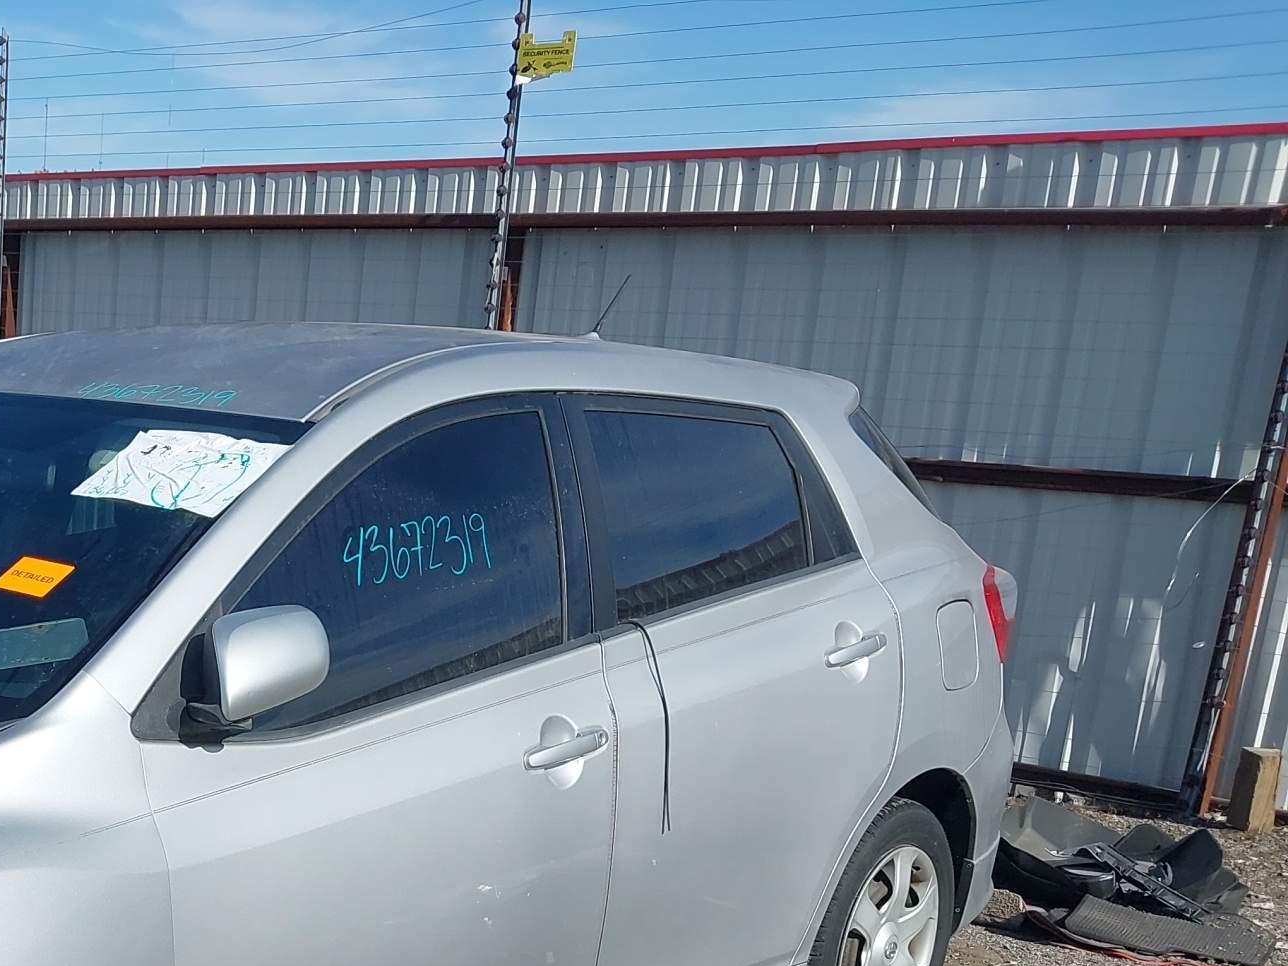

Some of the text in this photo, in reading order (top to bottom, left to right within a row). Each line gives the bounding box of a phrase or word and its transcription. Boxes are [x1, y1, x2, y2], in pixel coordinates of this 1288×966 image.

[78, 382, 239, 407] 43672319
[343, 513, 492, 586] 43672319
[12, 569, 54, 584] DETAILED
